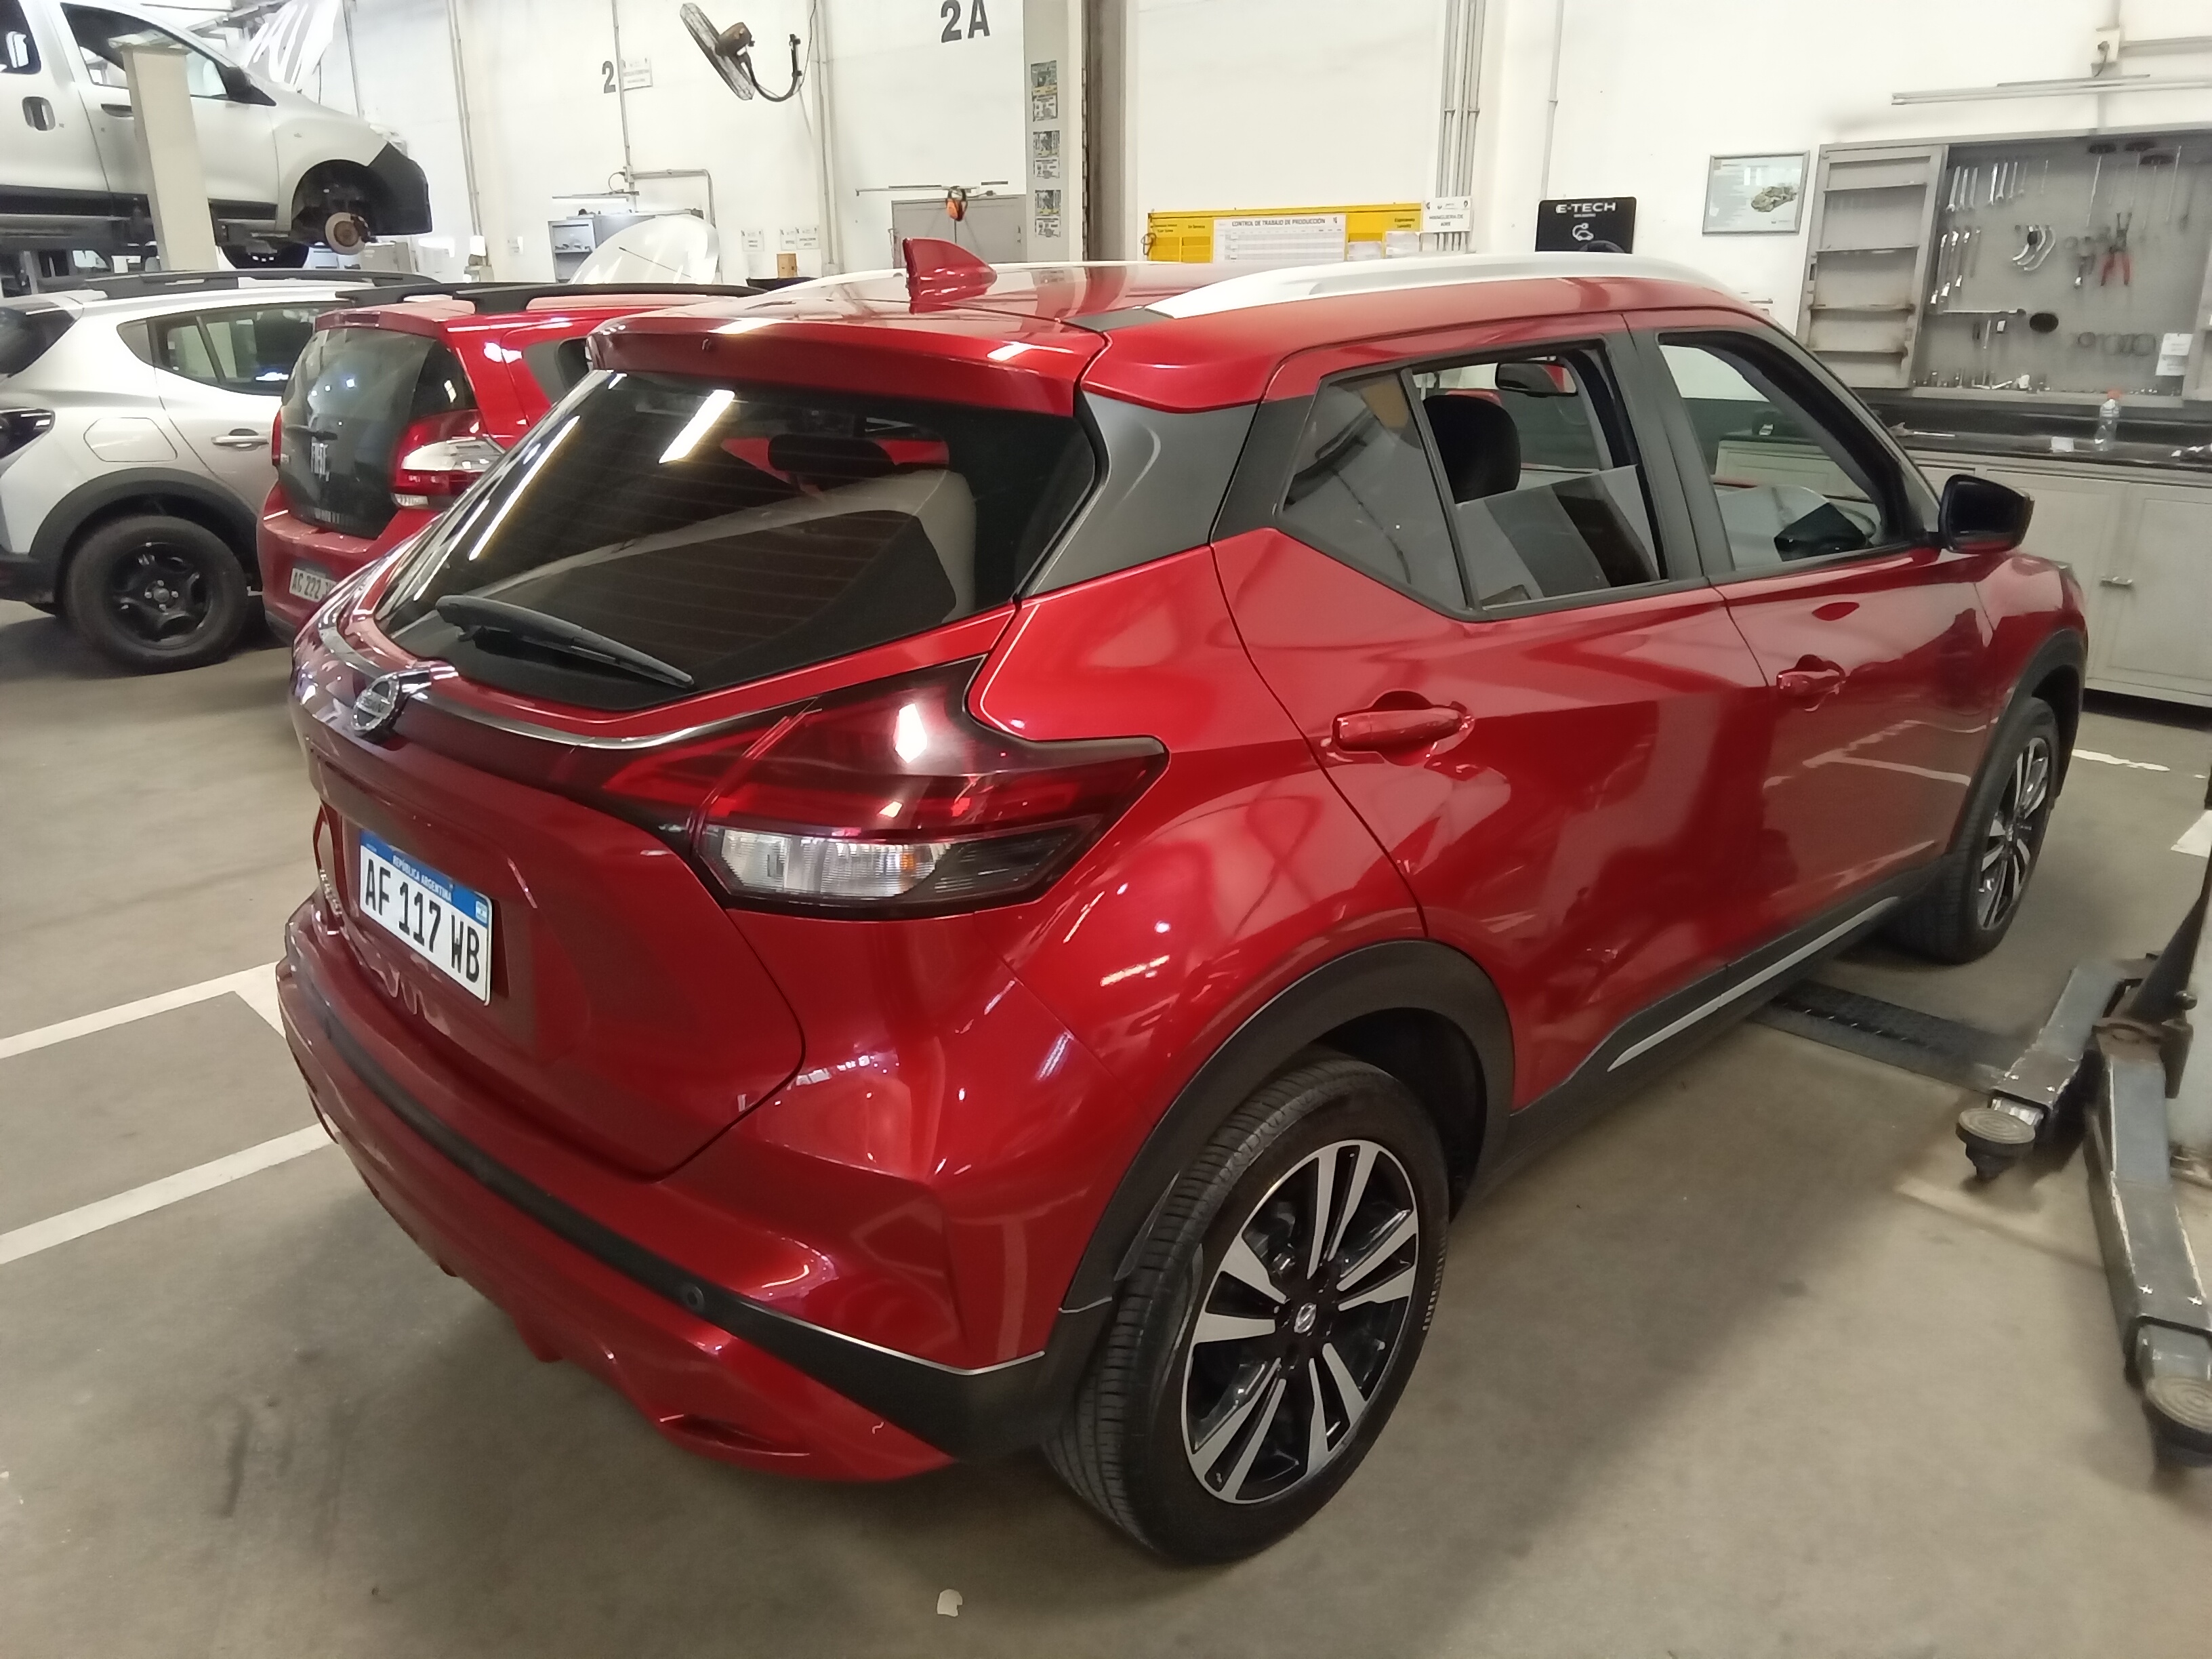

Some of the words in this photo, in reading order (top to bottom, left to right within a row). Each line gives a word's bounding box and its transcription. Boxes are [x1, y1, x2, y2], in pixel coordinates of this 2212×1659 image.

[602, 60, 616, 94] 2
[1555, 202, 1616, 213] E-TECH
[304, 575, 321, 600] 222
[392, 855, 420, 882] REPÚBLICA
[421, 874, 453, 903] ARGENTINA
[365, 858, 391, 916] AF
[398, 881, 441, 953] 117
[451, 914, 480, 983] WB
